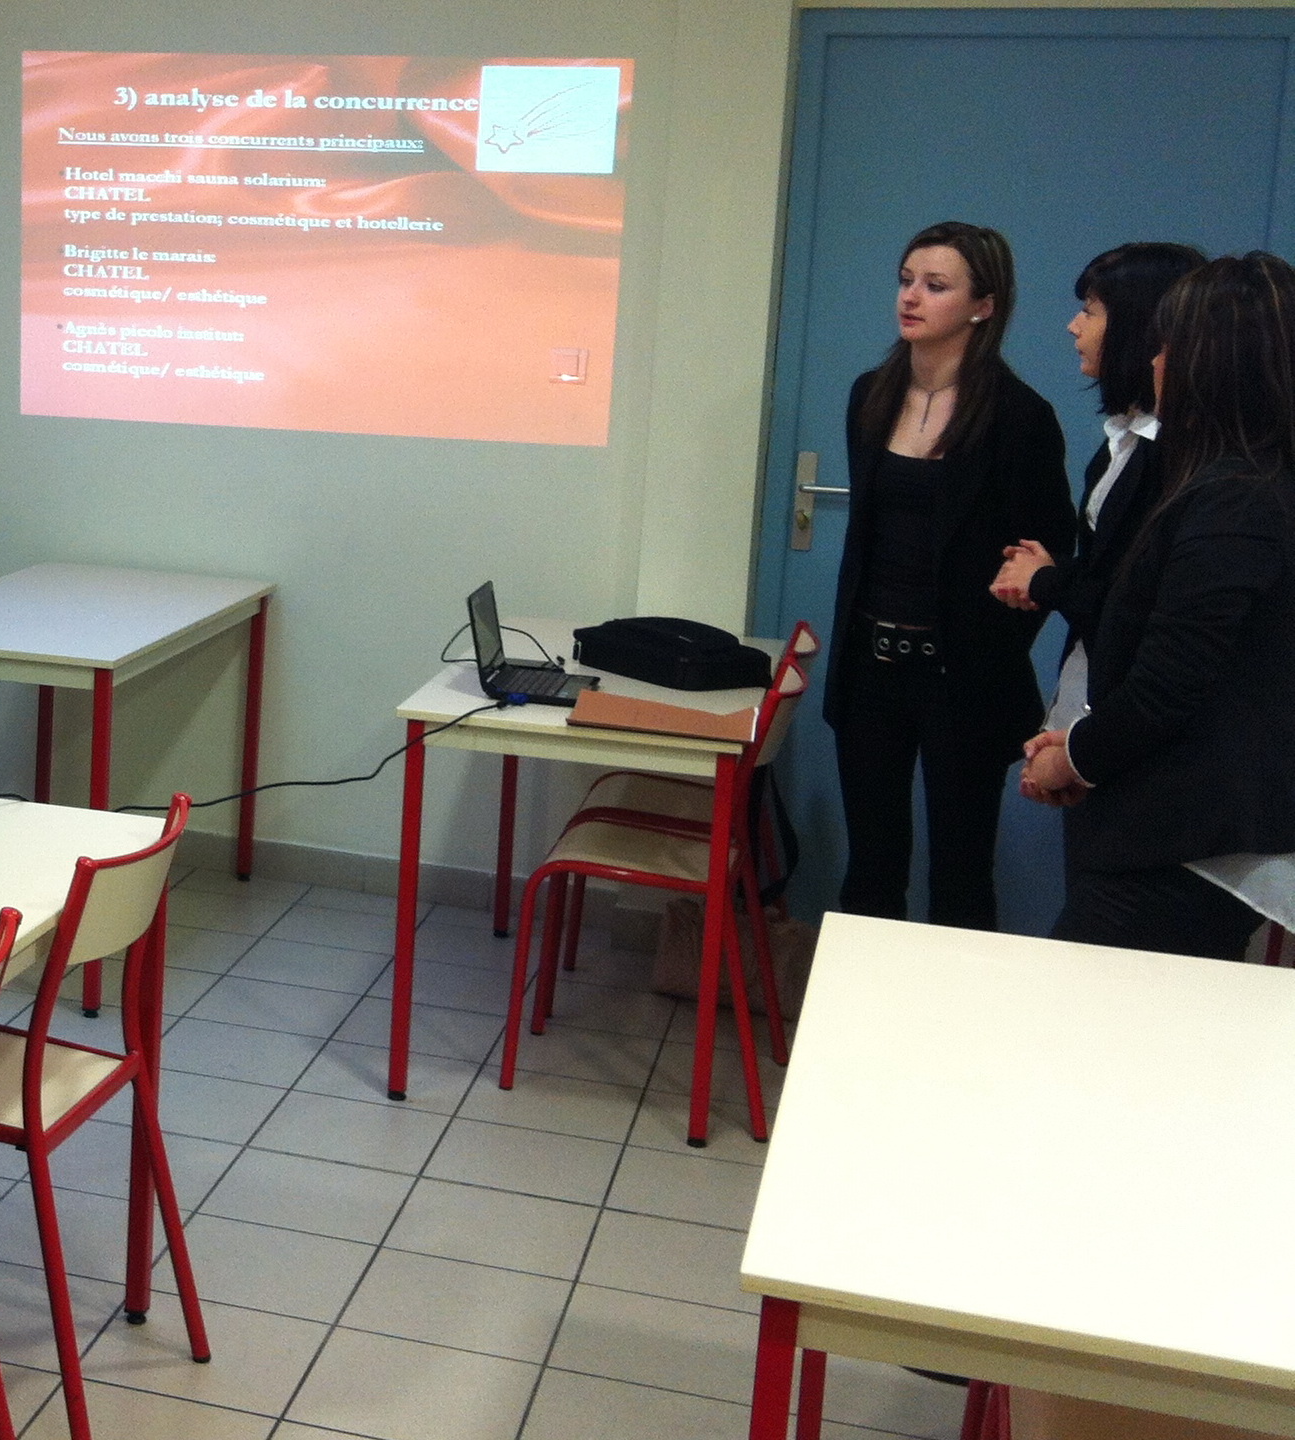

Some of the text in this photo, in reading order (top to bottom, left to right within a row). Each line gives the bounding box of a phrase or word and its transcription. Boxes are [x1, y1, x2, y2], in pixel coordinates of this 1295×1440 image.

[113, 87, 479, 113] 3) analyse de la concurrence
[58, 127, 424, 150] Nous avons trois concurrents principaux:
[65, 167, 114, 181] Hotel
[187, 173, 239, 185] sauna
[244, 173, 326, 188] solarium:
[64, 186, 151, 202] CHATEL
[64, 208, 444, 231] type de prestation; cosmétique et hotellerie
[64, 244, 129, 262] Brigitte
[132, 247, 149, 260] le
[63, 264, 150, 280] CHATEL
[63, 286, 268, 308] cosmétique/ esthétique
[64, 321, 117, 338] Agnès
[120, 325, 174, 340] picolo
[62, 340, 149, 357] CHATEL
[62, 361, 266, 384] cosmétique/ esthétique
